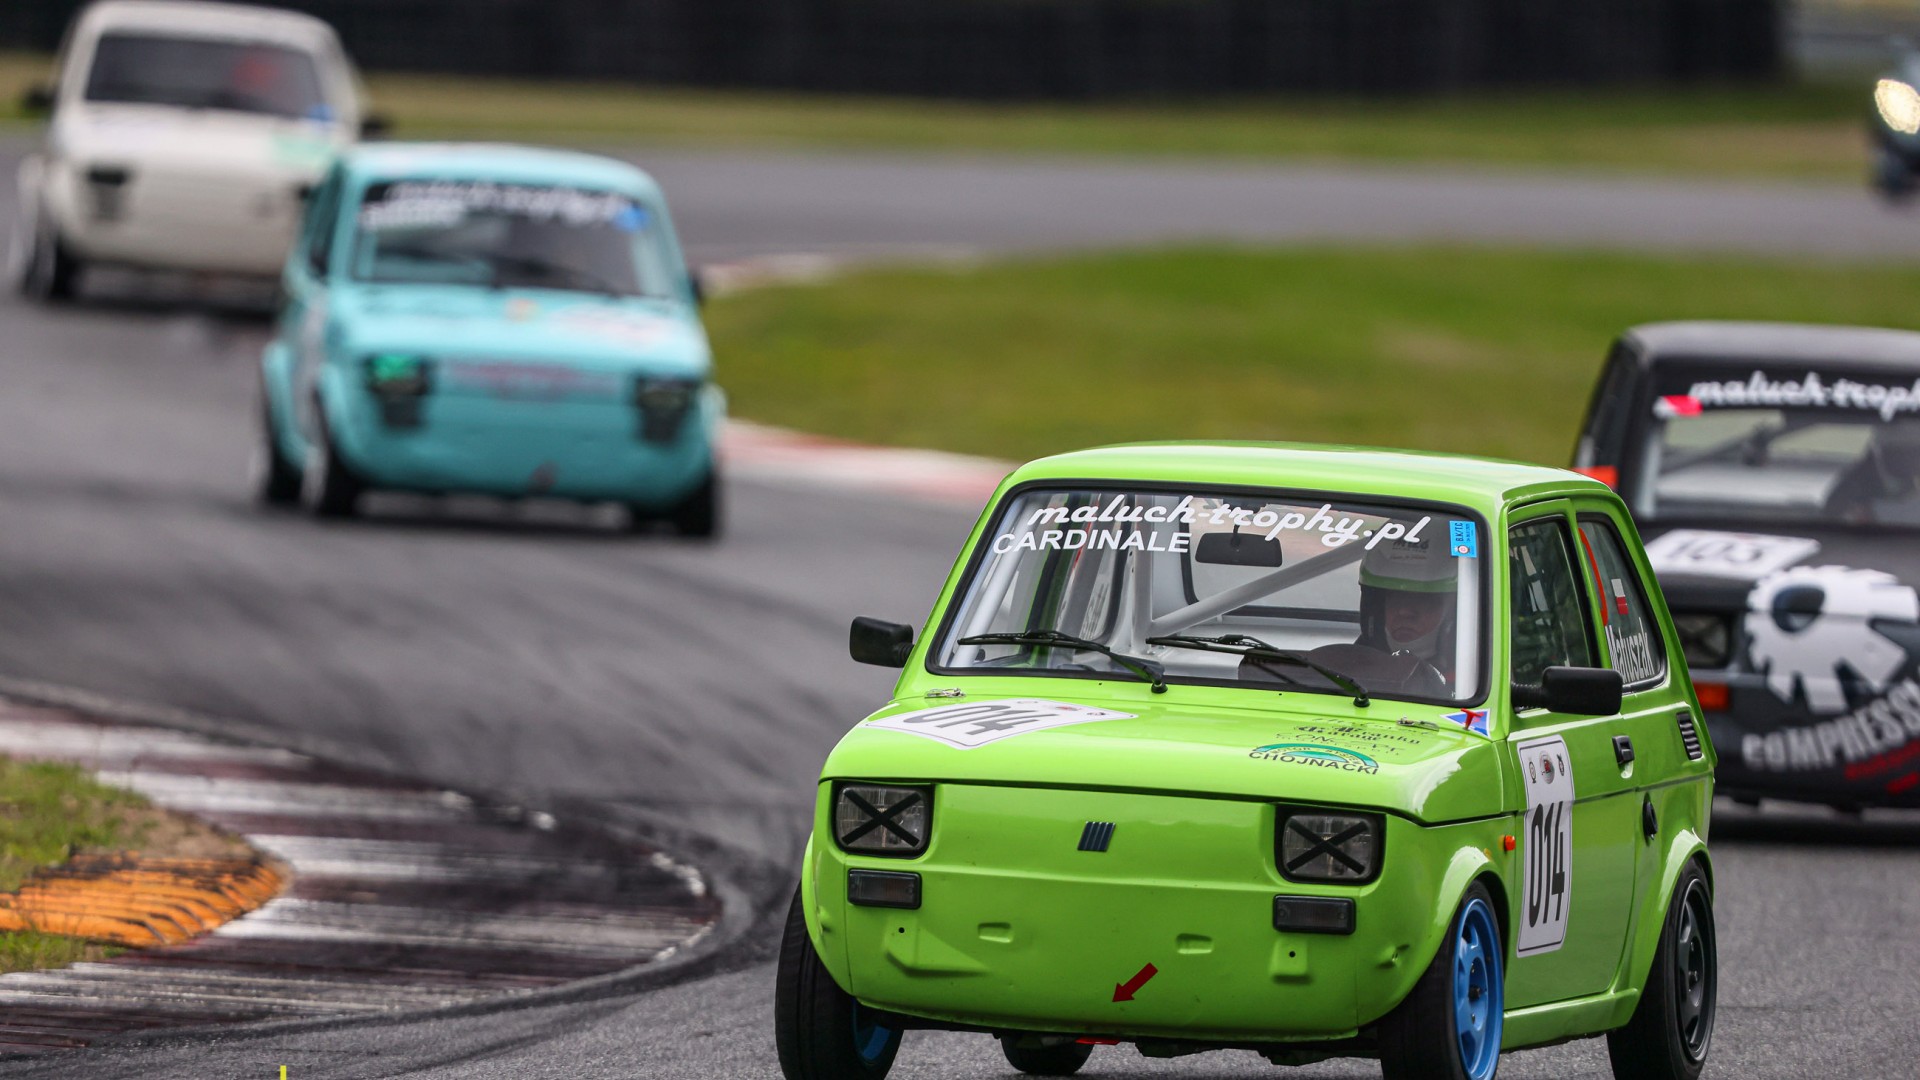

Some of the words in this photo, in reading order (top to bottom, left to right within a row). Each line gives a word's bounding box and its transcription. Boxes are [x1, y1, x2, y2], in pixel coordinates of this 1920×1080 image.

[1027, 493, 1431, 551] maluch-trophy.pl
[993, 528, 1192, 554] CARDINALE
[902, 705, 1058, 736] 014
[1249, 751, 1379, 775] CHOJNACKI
[1529, 801, 1565, 928] 014
